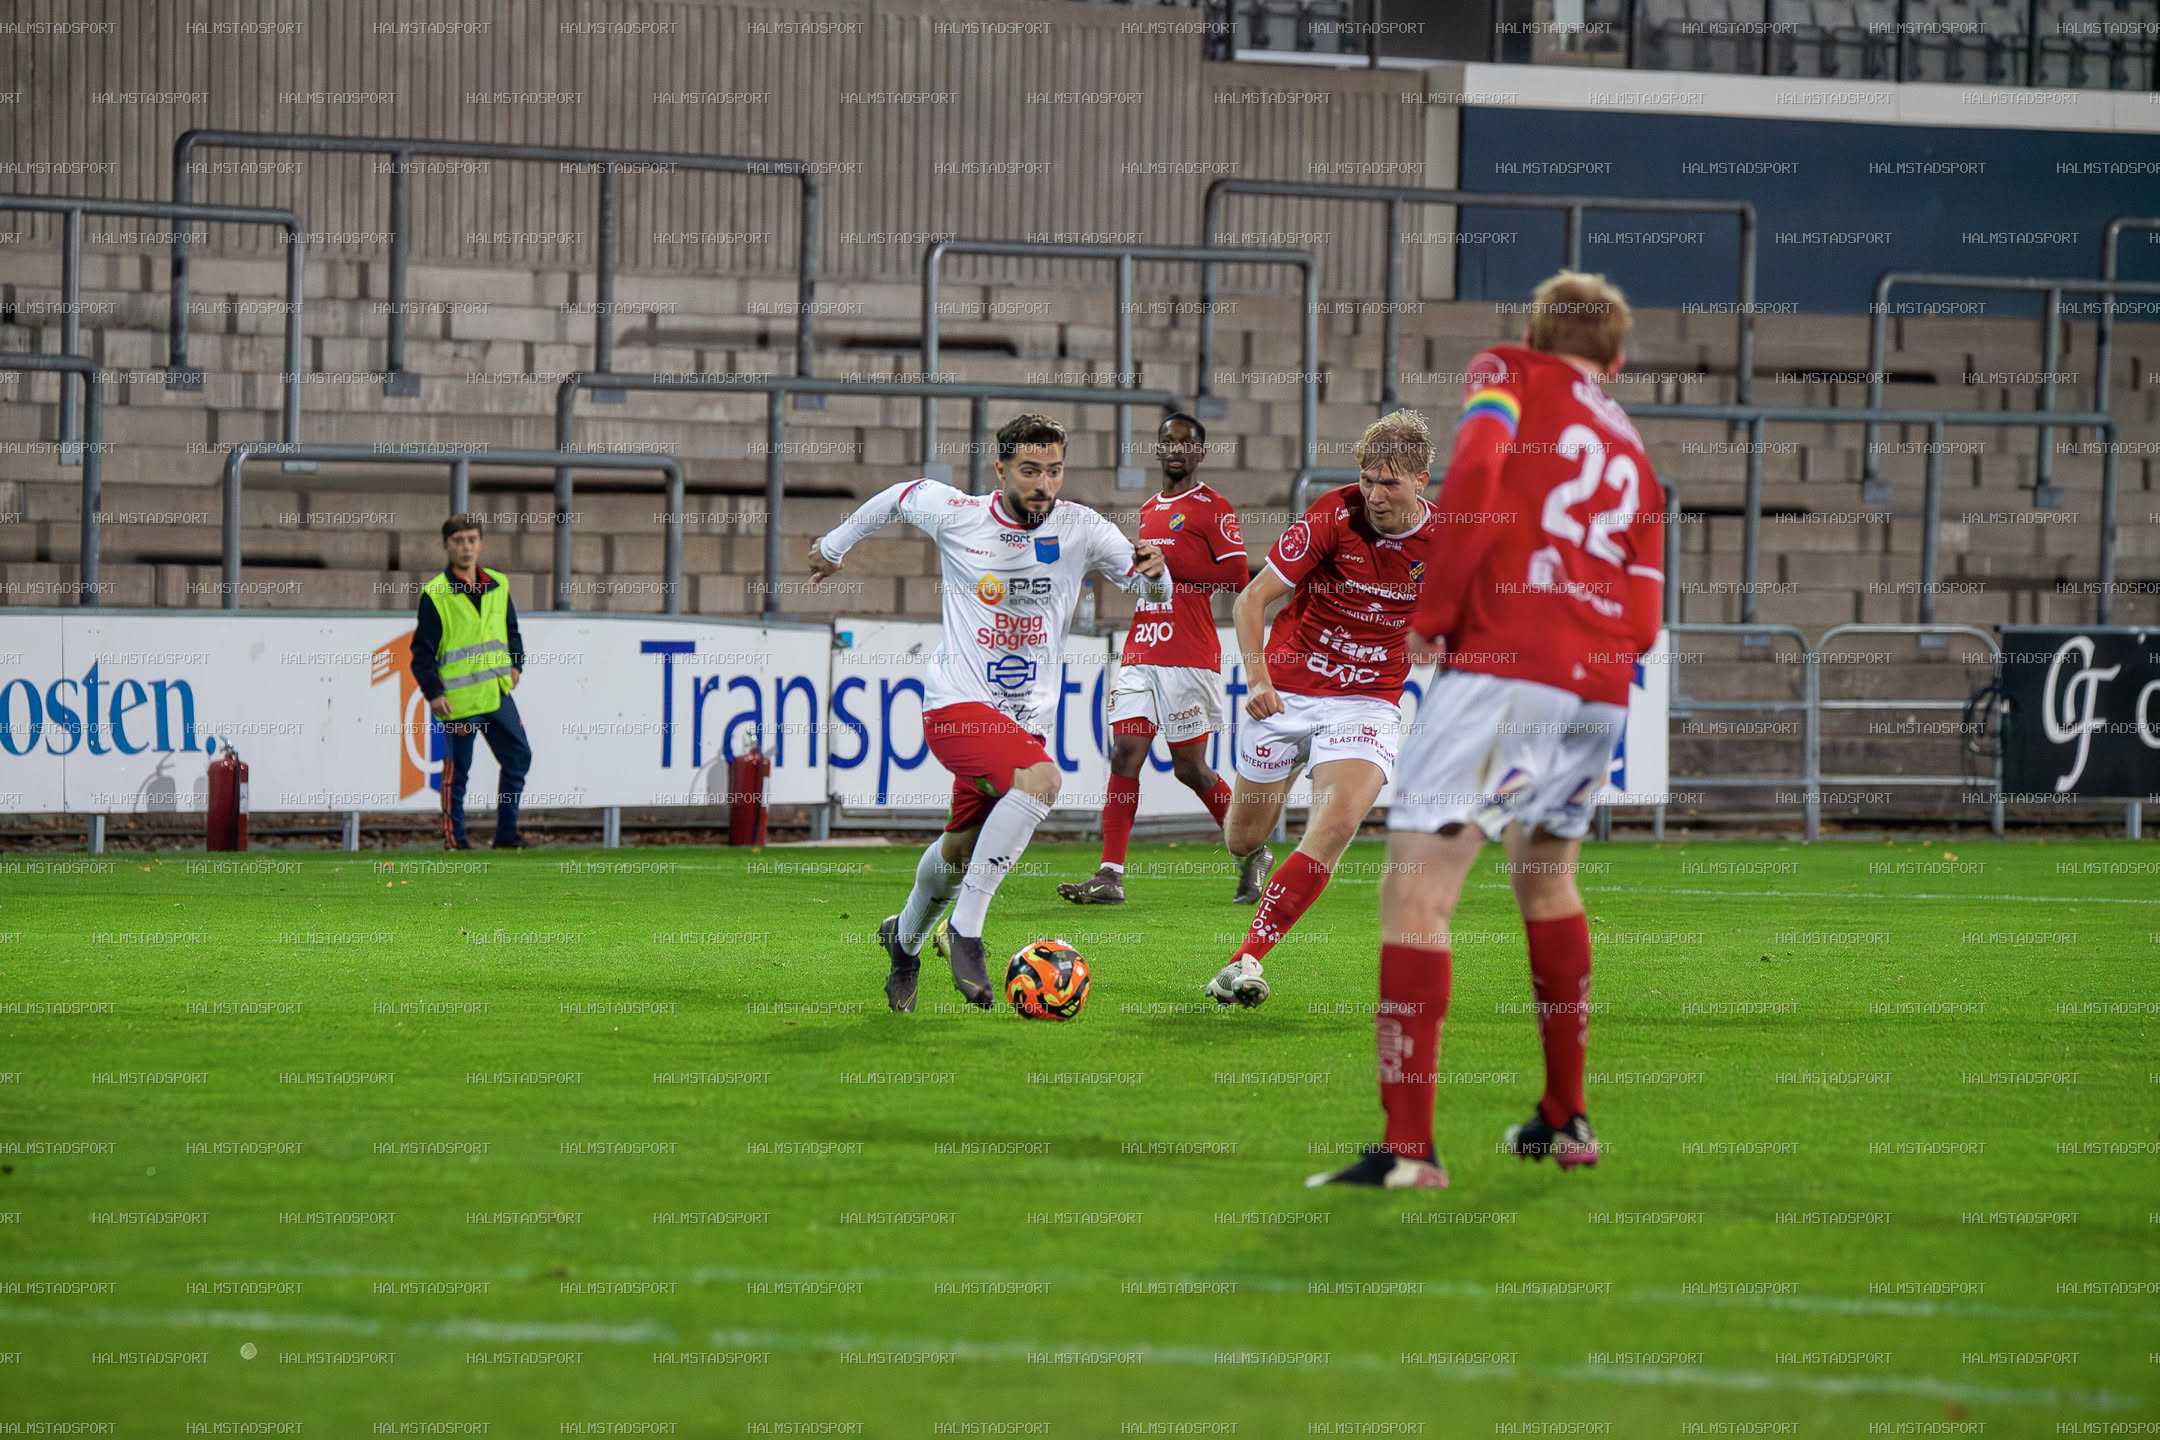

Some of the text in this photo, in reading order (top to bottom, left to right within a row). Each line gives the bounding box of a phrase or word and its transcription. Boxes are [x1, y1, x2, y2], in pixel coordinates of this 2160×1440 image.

[1541, 424, 1640, 567] 22
[999, 533, 1031, 544] sport
[965, 548, 989, 557] CRAFT
[994, 612, 1043, 634] Bygg
[1134, 621, 1174, 647] axjo
[977, 627, 1048, 651] Sjögren
[640, 640, 1082, 805] Transpt
[1252, 881, 1287, 930] OFFICE
